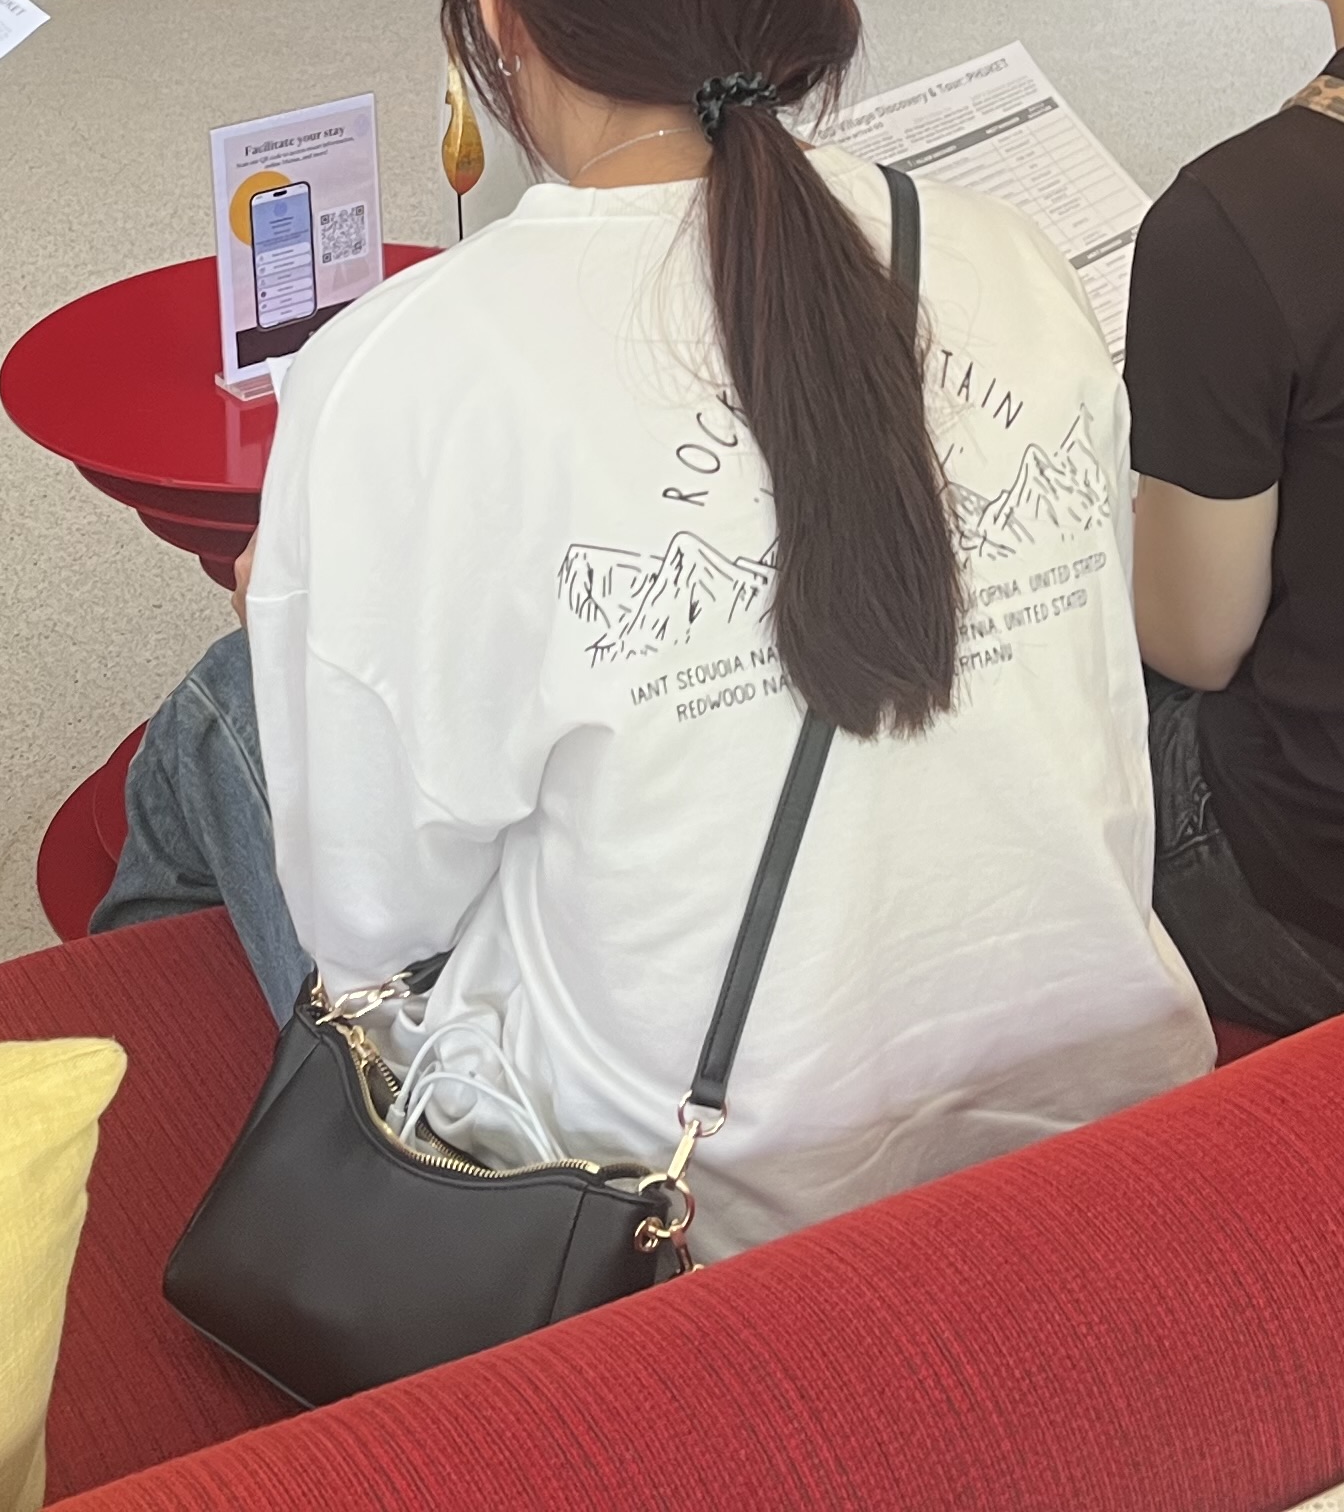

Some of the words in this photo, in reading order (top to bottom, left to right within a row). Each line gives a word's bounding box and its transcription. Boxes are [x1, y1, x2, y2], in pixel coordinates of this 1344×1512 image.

[245, 137, 295, 157] Facilitate
[297, 131, 321, 147] your
[323, 127, 345, 138] stay
[840, 112, 875, 131] Village
[875, 92, 928, 117] Discovery
[965, 58, 1008, 82] PHUKET
[662, 390, 749, 506] ROCK
[941, 350, 1023, 429] TAIN
[676, 655, 744, 690] SEQUOIA
[750, 646, 778, 668] NA
[1029, 564, 1071, 592] UNITED
[676, 682, 756, 722] REDWOOD
[762, 674, 790, 696] NA
[1004, 603, 1049, 631] UNITED
